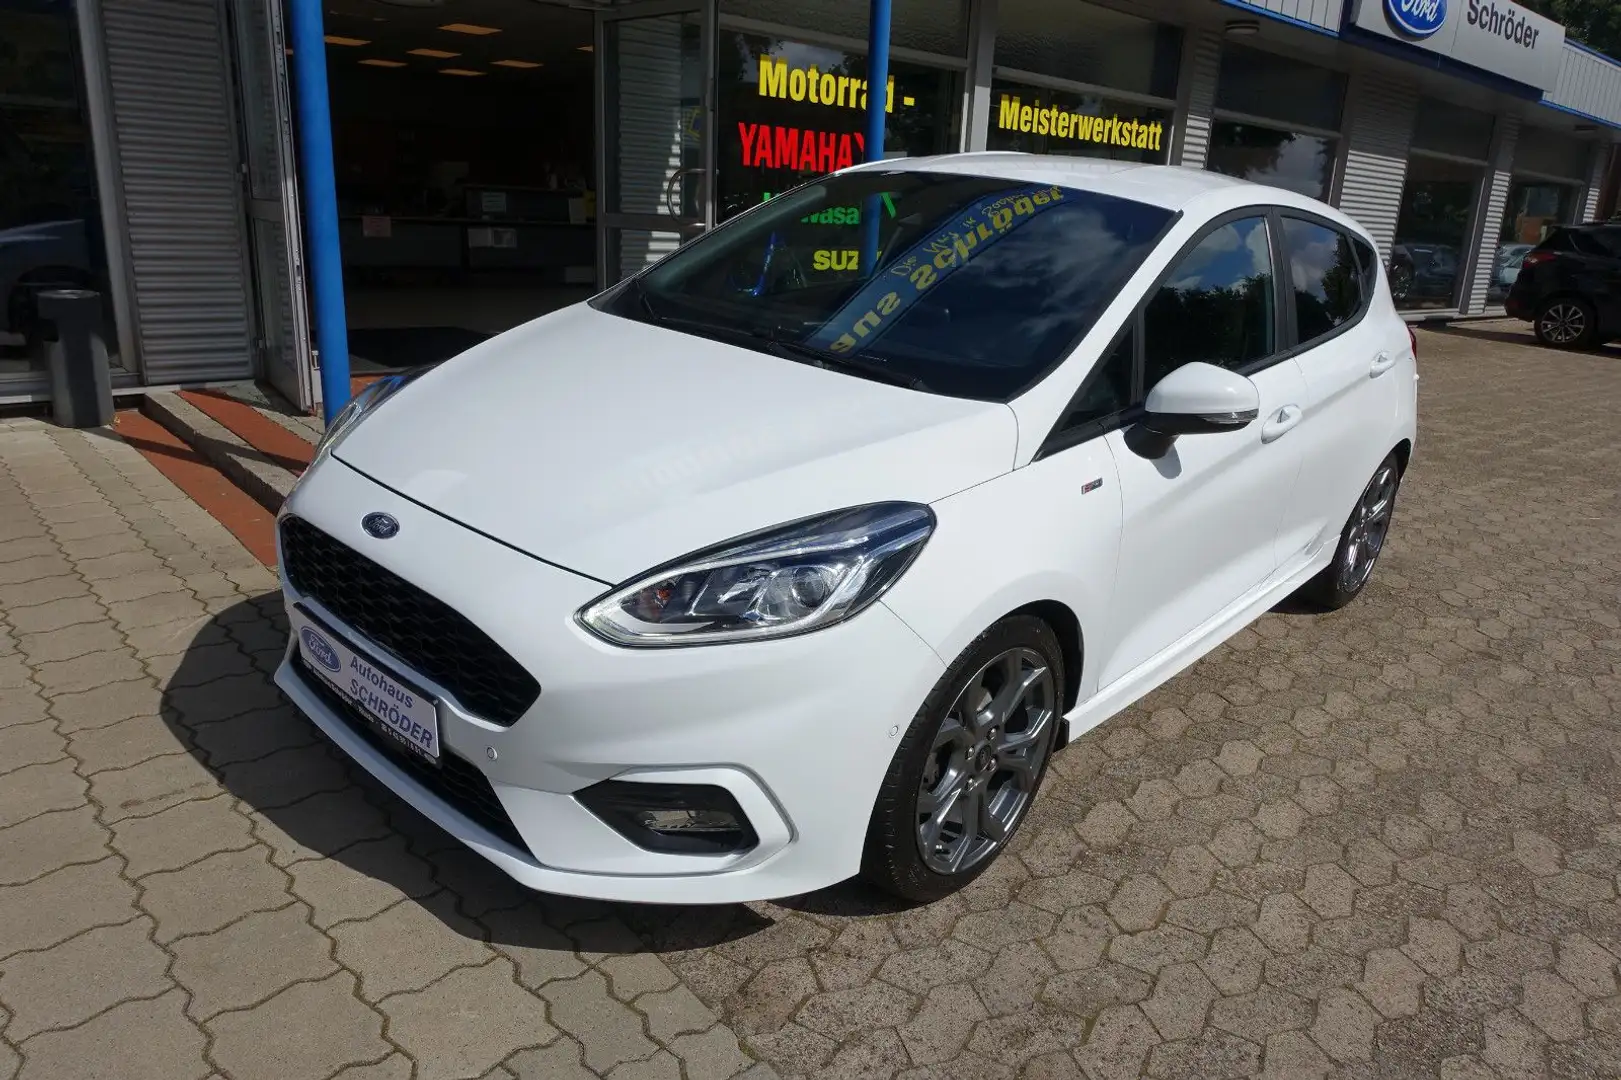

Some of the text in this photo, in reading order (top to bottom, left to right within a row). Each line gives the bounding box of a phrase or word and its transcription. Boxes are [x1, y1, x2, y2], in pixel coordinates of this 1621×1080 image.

[1467, 0, 1539, 49] Schröder
[999, 94, 1163, 151] Meisterwerkstatt
[350, 656, 414, 709] Autohaus
[349, 679, 433, 749] SCHRÖDER
